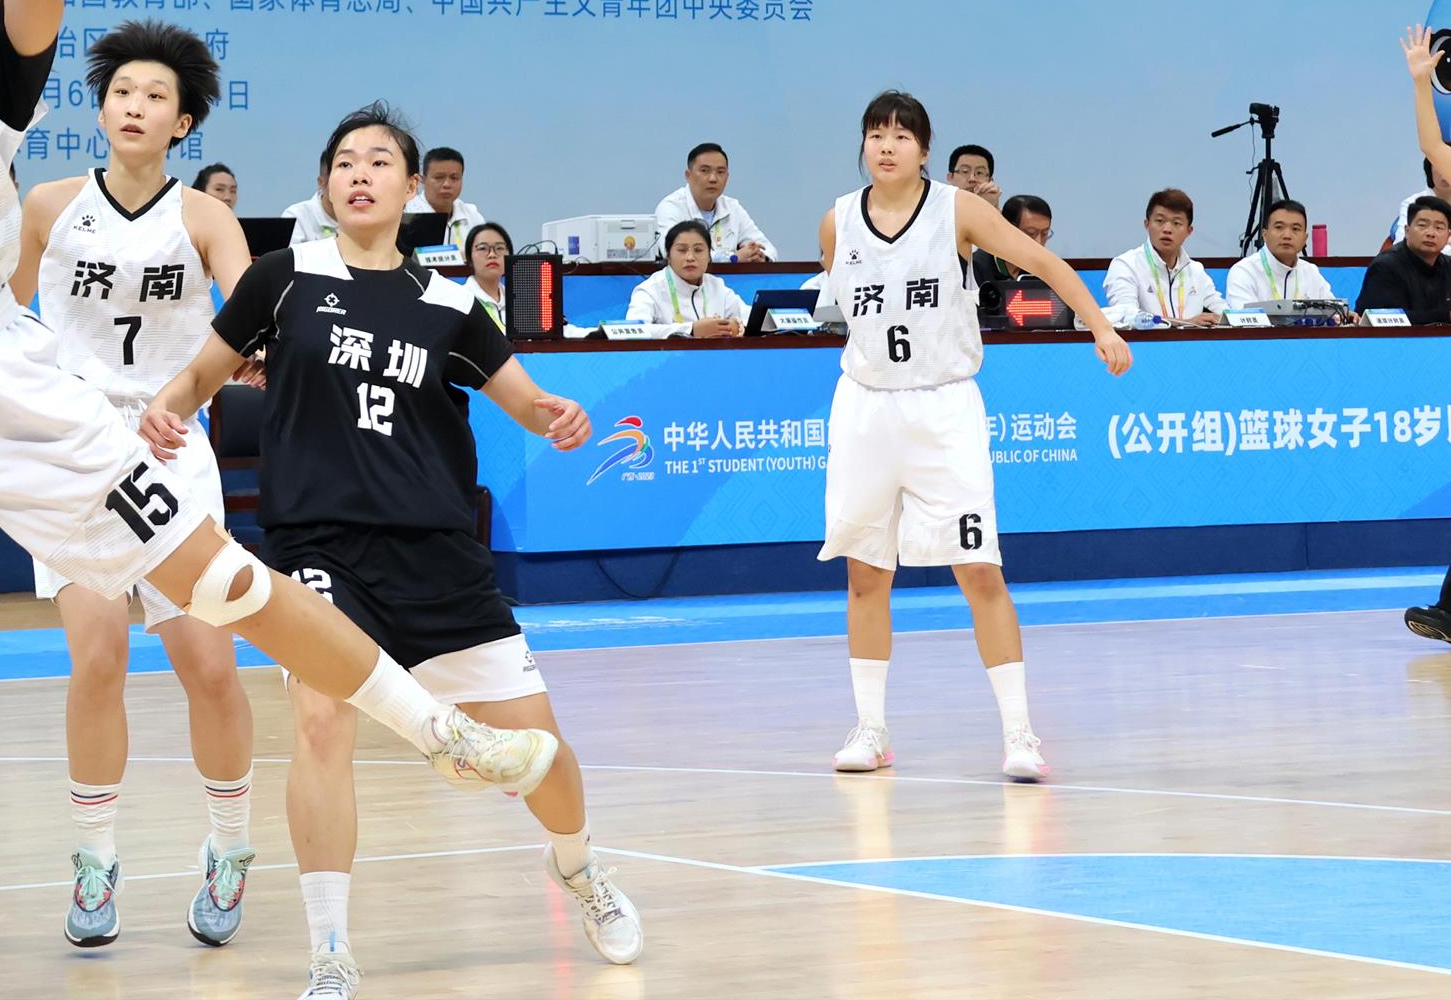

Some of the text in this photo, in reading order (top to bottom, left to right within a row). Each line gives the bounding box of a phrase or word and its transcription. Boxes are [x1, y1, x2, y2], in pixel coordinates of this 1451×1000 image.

[70, 260, 186, 302] 济南
[852, 277, 940, 318] 济南
[113, 316, 143, 366] 7
[327, 323, 429, 389] 深圳
[887, 324, 912, 363] 6
[356, 382, 396, 437] 12
[664, 459, 689, 474] THE
[708, 458, 764, 473] STUDENT
[766, 455, 817, 472] (YOUTH)
[1023, 450, 1039, 463] OF
[1042, 448, 1078, 463] CHINA
[104, 461, 179, 544] 15
[958, 513, 983, 551] 6
